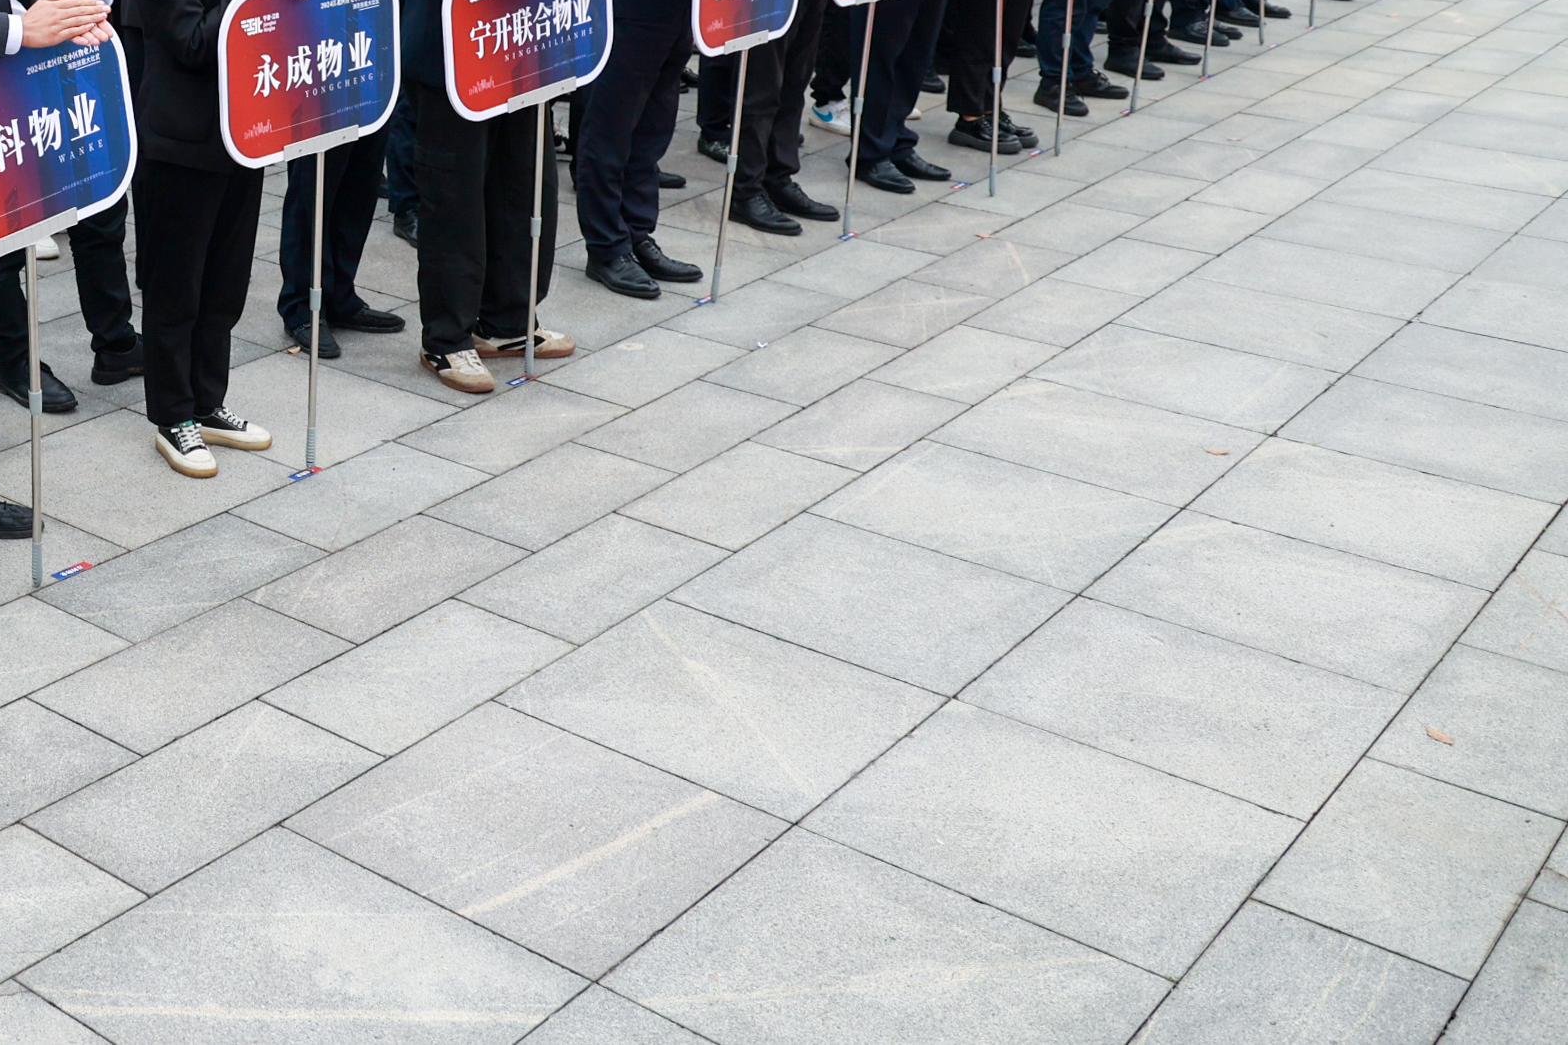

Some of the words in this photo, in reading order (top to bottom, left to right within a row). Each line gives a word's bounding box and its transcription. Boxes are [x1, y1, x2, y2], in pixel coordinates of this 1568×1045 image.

[504, 26, 594, 62] NINGKAILIANHE
[252, 30, 374, 98] 永成物业
[304, 72, 375, 98] YONGCHENG
[58, 139, 104, 163] WANKE
